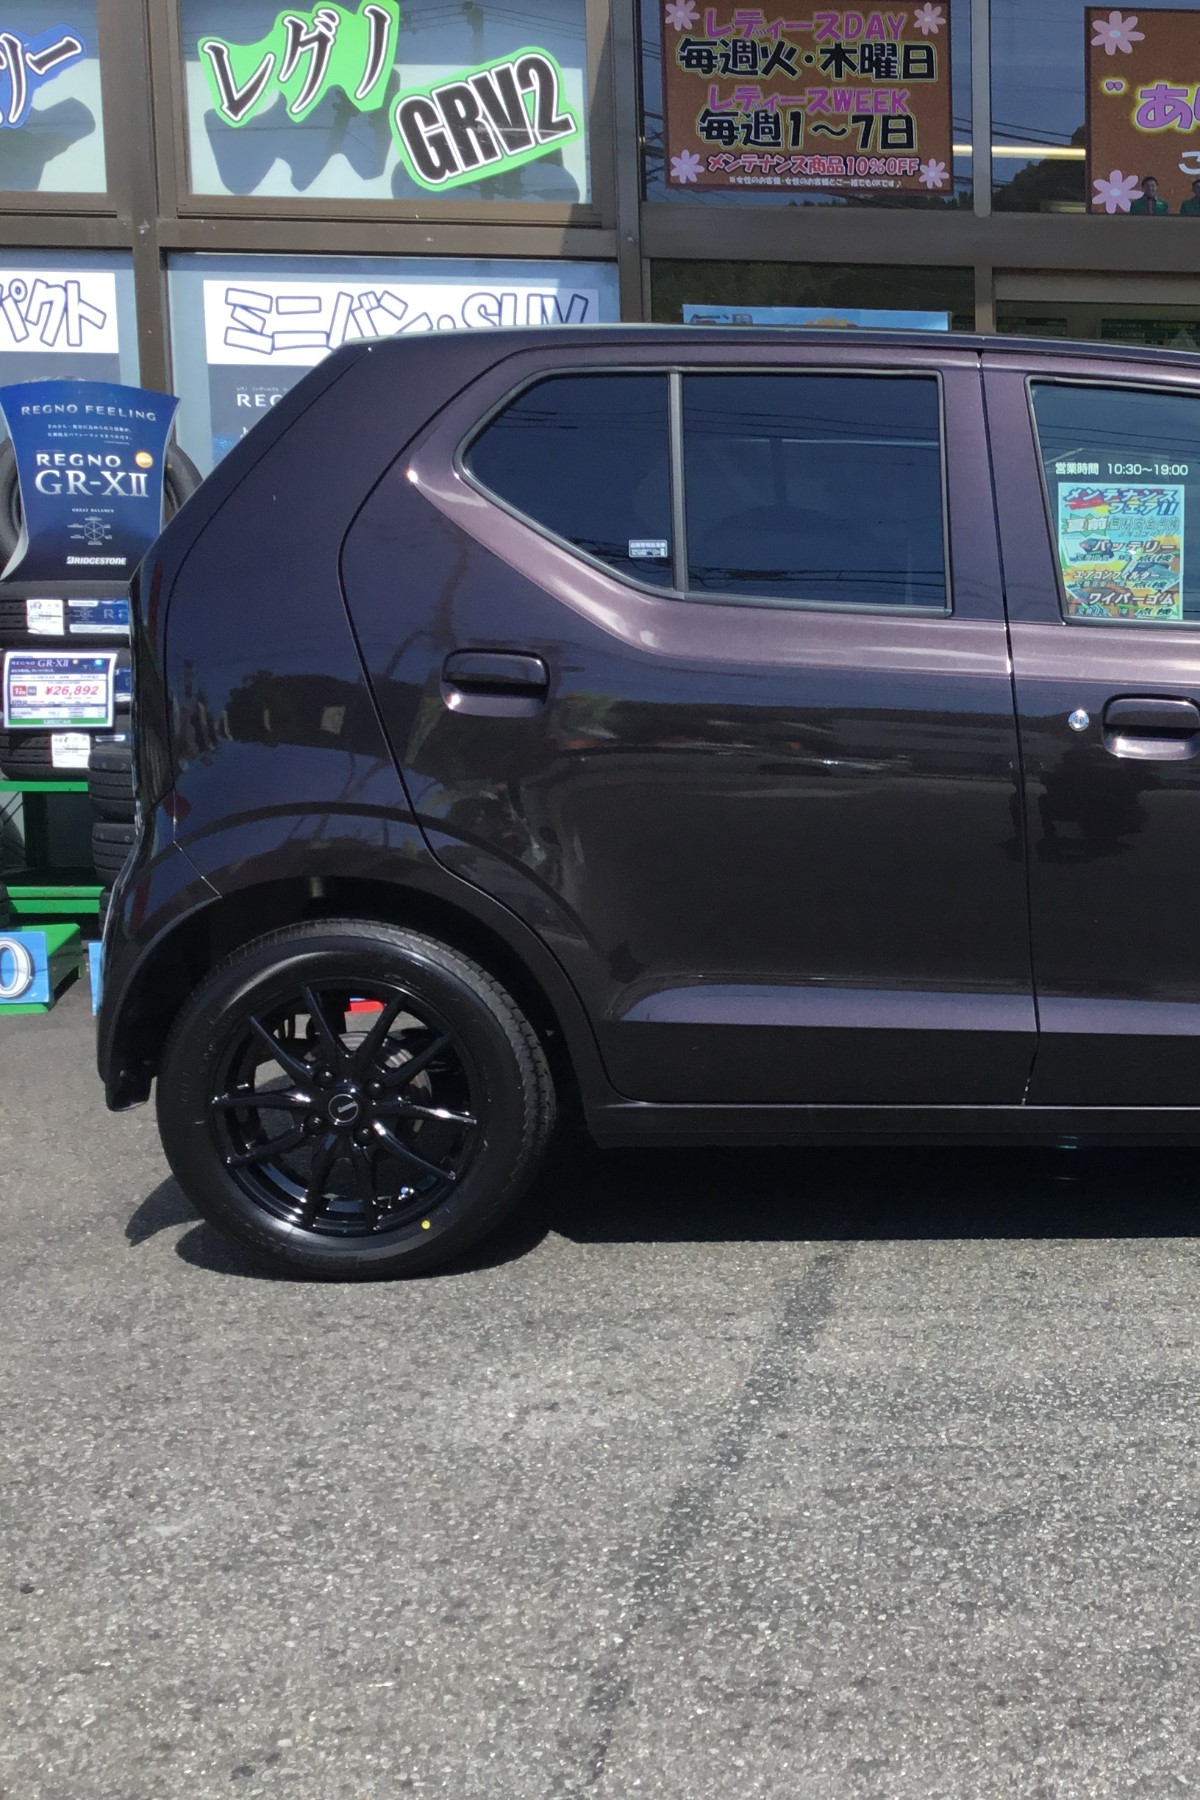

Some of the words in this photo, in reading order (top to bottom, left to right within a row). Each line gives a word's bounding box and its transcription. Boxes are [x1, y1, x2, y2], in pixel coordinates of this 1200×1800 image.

[706, 10, 906, 41] レディースDAY
[204, 5, 391, 121] レグノ
[679, 37, 936, 81] 毎週火・木曜日
[708, 86, 909, 114] レディースWEEK
[21, 404, 78, 416] REGNO
[85, 405, 157, 422] FEELING
[36, 453, 121, 468] REGNO
[1055, 462, 1099, 476] 営業時間
[1064, 487, 1178, 502] メンテナンス
[66, 556, 127, 566] BRIDGESTONE
[44, 686, 100, 697] ¥26,892
